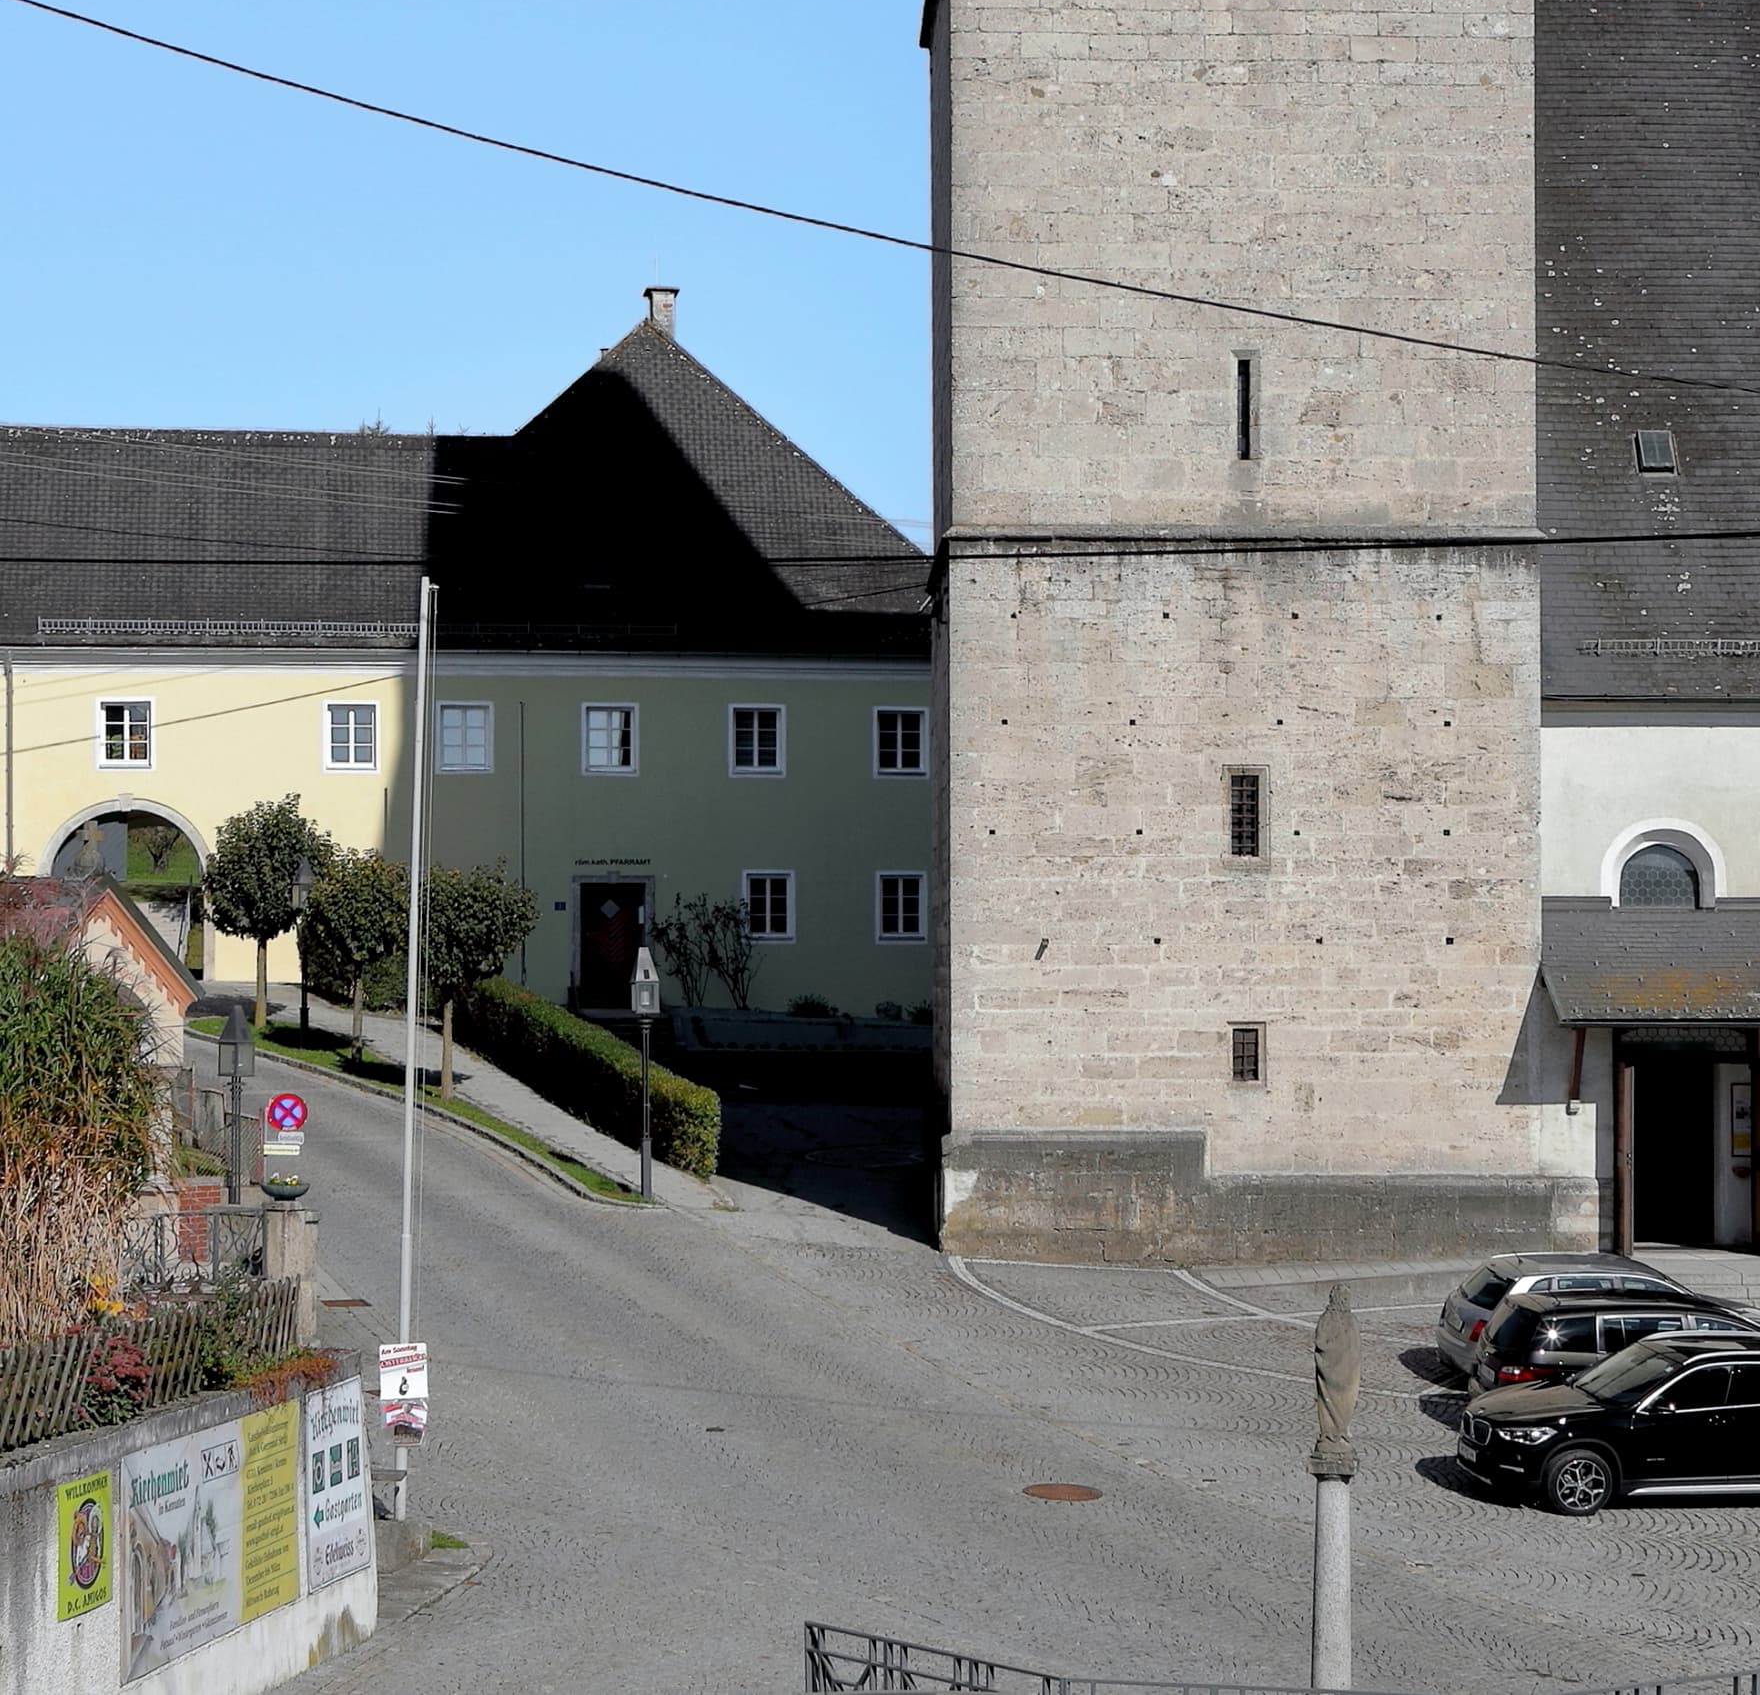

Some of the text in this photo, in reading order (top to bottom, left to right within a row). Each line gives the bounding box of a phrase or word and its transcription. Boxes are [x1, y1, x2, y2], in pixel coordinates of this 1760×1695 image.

[610, 858, 651, 866] PFARRAMT
[311, 1398, 359, 1441] Kirchenwirt
[129, 1459, 189, 1509] Kirchenwirt
[325, 1492, 362, 1522] Gastgarten
[83, 1586, 107, 1607] AMIGOS
